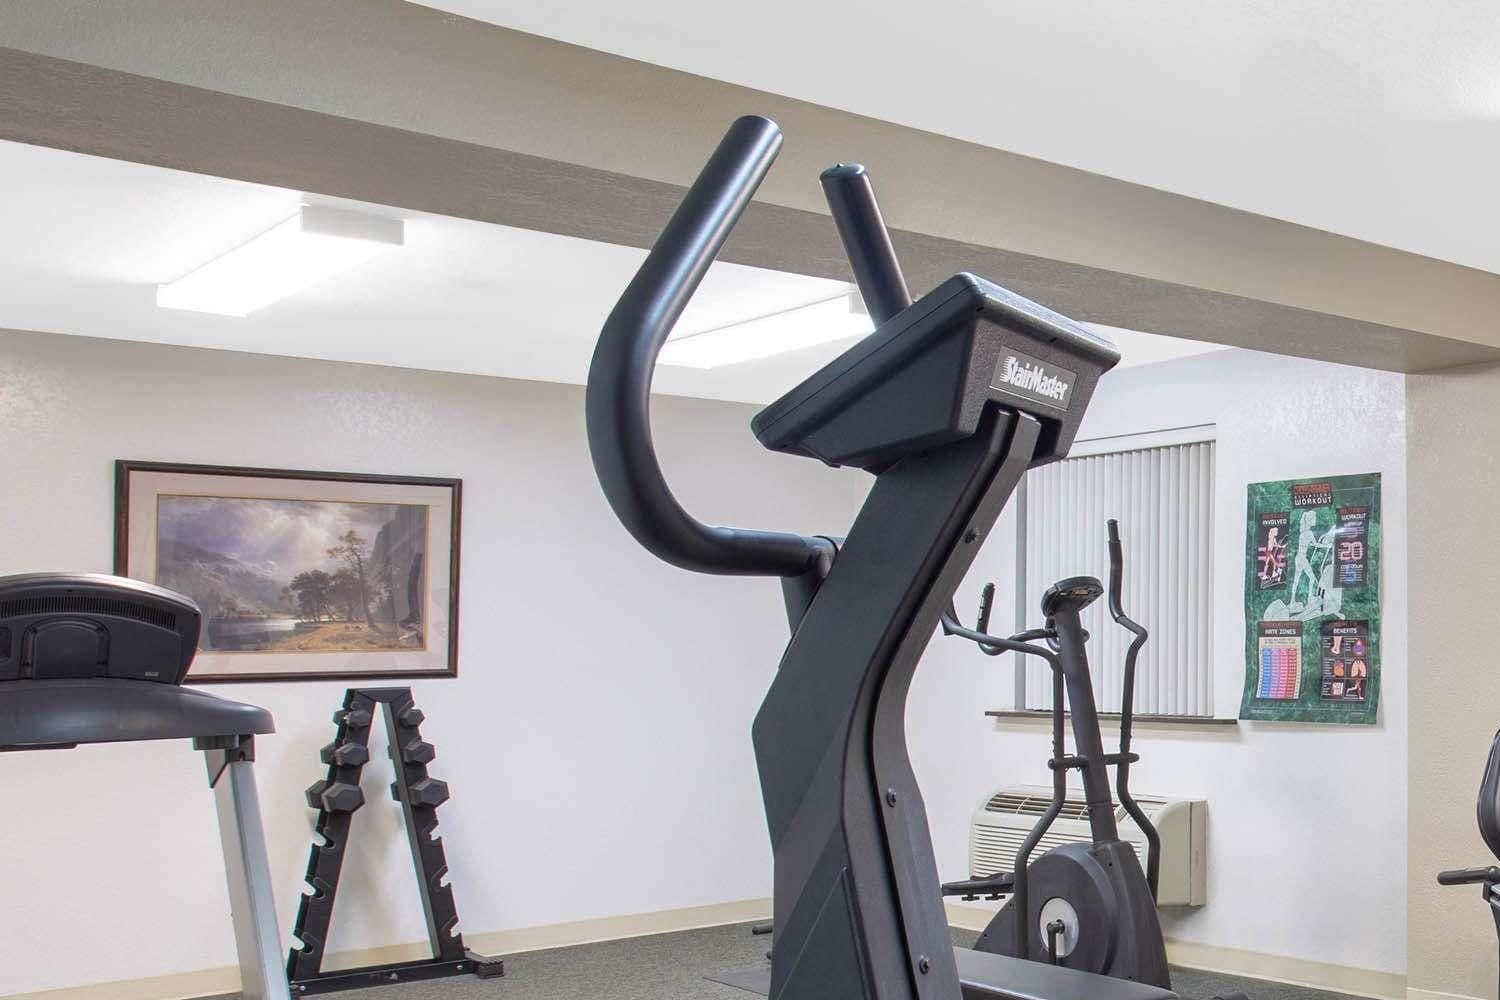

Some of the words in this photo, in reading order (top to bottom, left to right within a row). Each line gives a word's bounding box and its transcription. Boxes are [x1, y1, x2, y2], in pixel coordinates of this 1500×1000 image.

[1000, 356, 1068, 400] StairMaster
[1294, 496, 1331, 505] WORKOUT
[1340, 541, 1364, 560] 20
